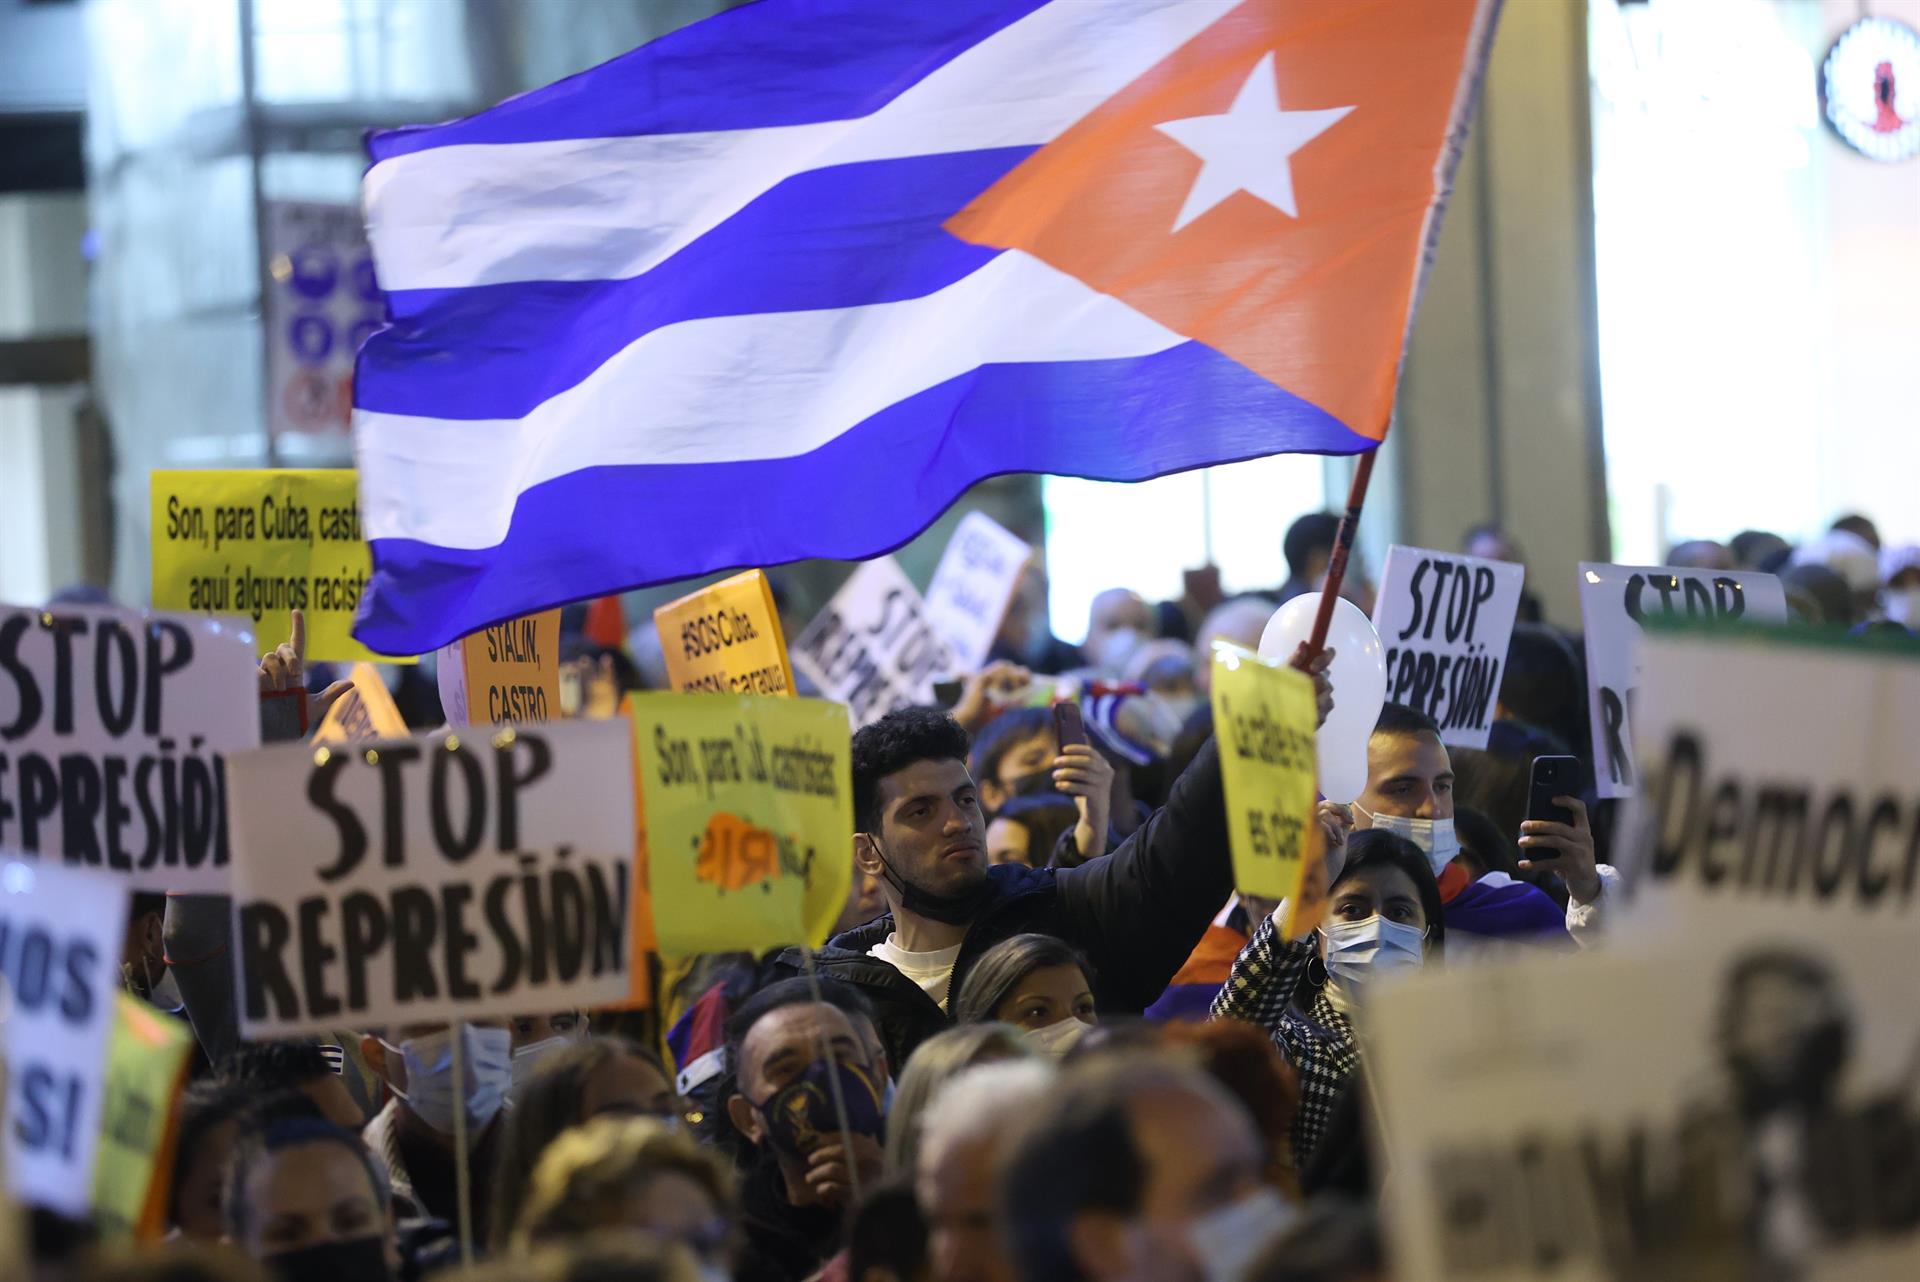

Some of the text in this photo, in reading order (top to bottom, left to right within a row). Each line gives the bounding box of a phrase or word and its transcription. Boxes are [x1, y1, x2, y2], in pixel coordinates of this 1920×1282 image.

[165, 494, 363, 551] Son, para Cuba, cast
[189, 565, 369, 623] aquí algunos racist
[485, 619, 541, 672] STALIN,
[1398, 557, 1496, 644] STOP
[0, 612, 195, 741] STOP
[306, 729, 554, 881] STOP
[0, 908, 98, 1028] OS
[240, 840, 630, 1022] REPRESIÓN
